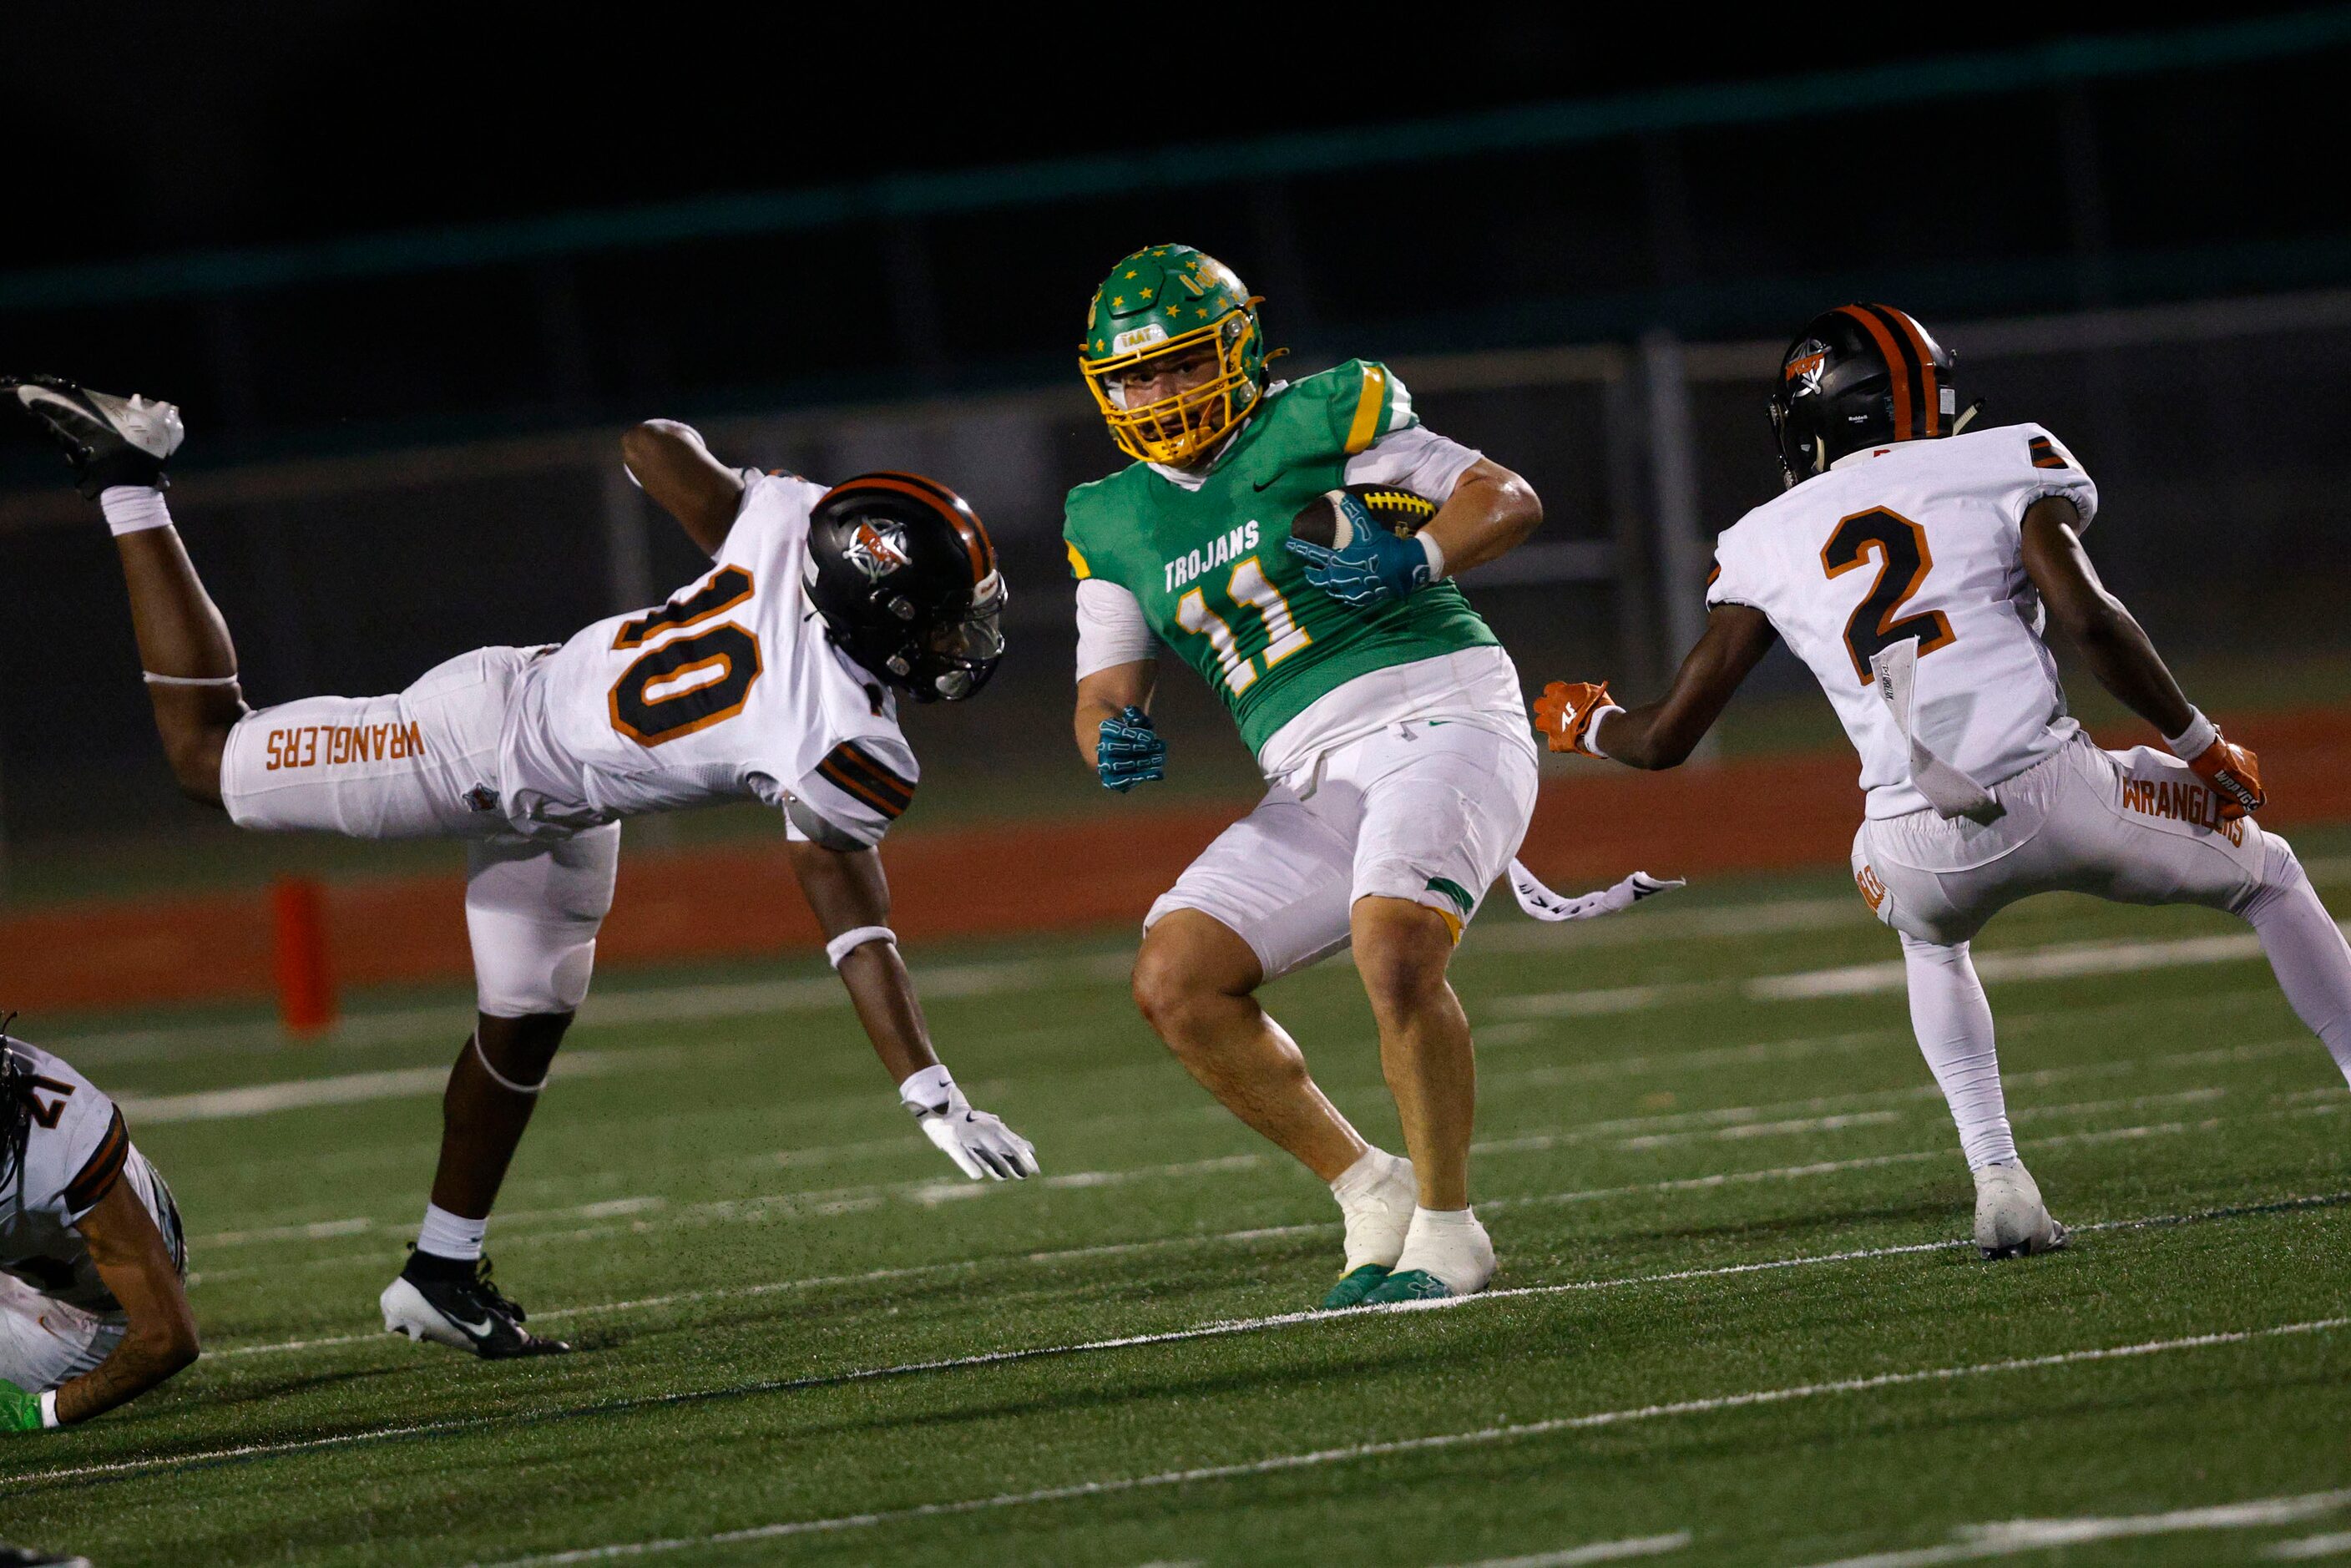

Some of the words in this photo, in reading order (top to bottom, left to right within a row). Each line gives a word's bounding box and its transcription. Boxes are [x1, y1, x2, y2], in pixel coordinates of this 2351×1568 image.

[1164, 519, 1260, 594] TROJANS
[1820, 505, 1957, 686] 2
[608, 564, 764, 748] 10
[1175, 554, 1314, 699] 11
[266, 721, 425, 771] WRANGLERS
[2122, 775, 2243, 848] WRANGLS
